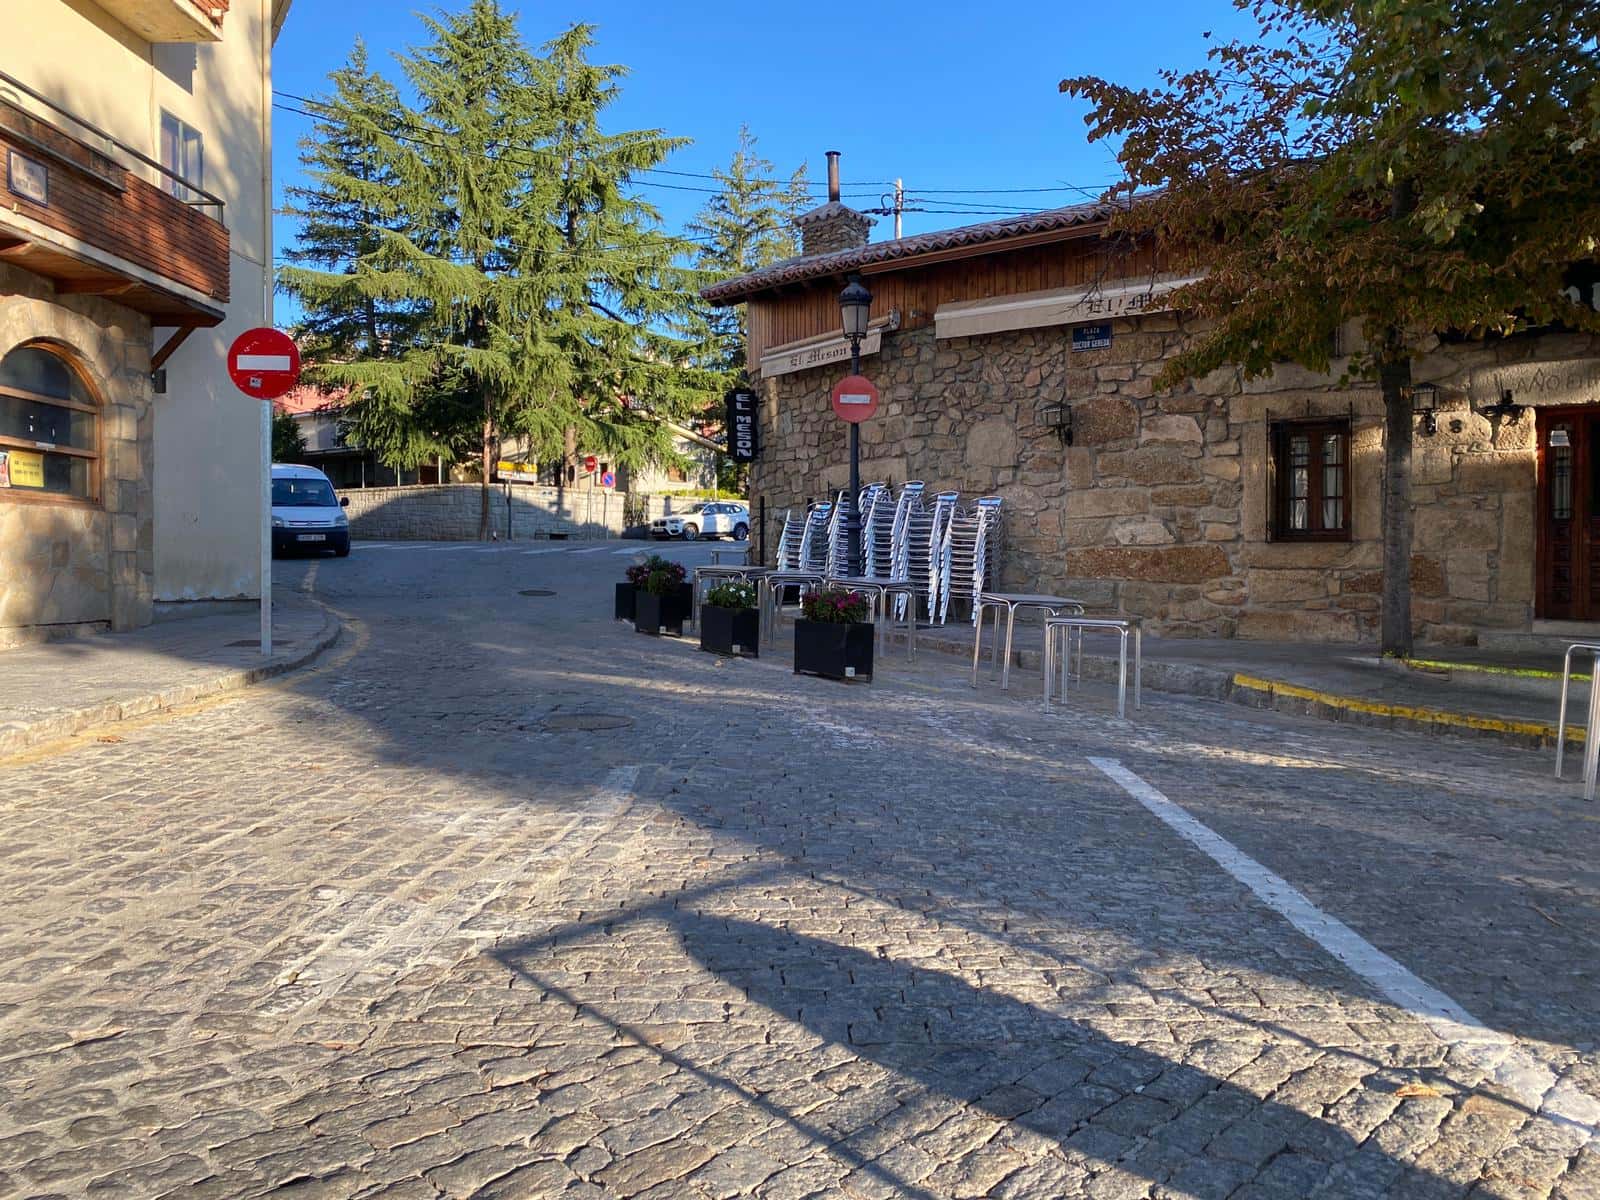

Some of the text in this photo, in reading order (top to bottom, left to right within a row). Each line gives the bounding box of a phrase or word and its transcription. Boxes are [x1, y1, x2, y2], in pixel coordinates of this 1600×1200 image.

[1083, 327, 1100, 335] PLAZA
[790, 353, 802, 366] El
[735, 393, 752, 457] EL MESON
